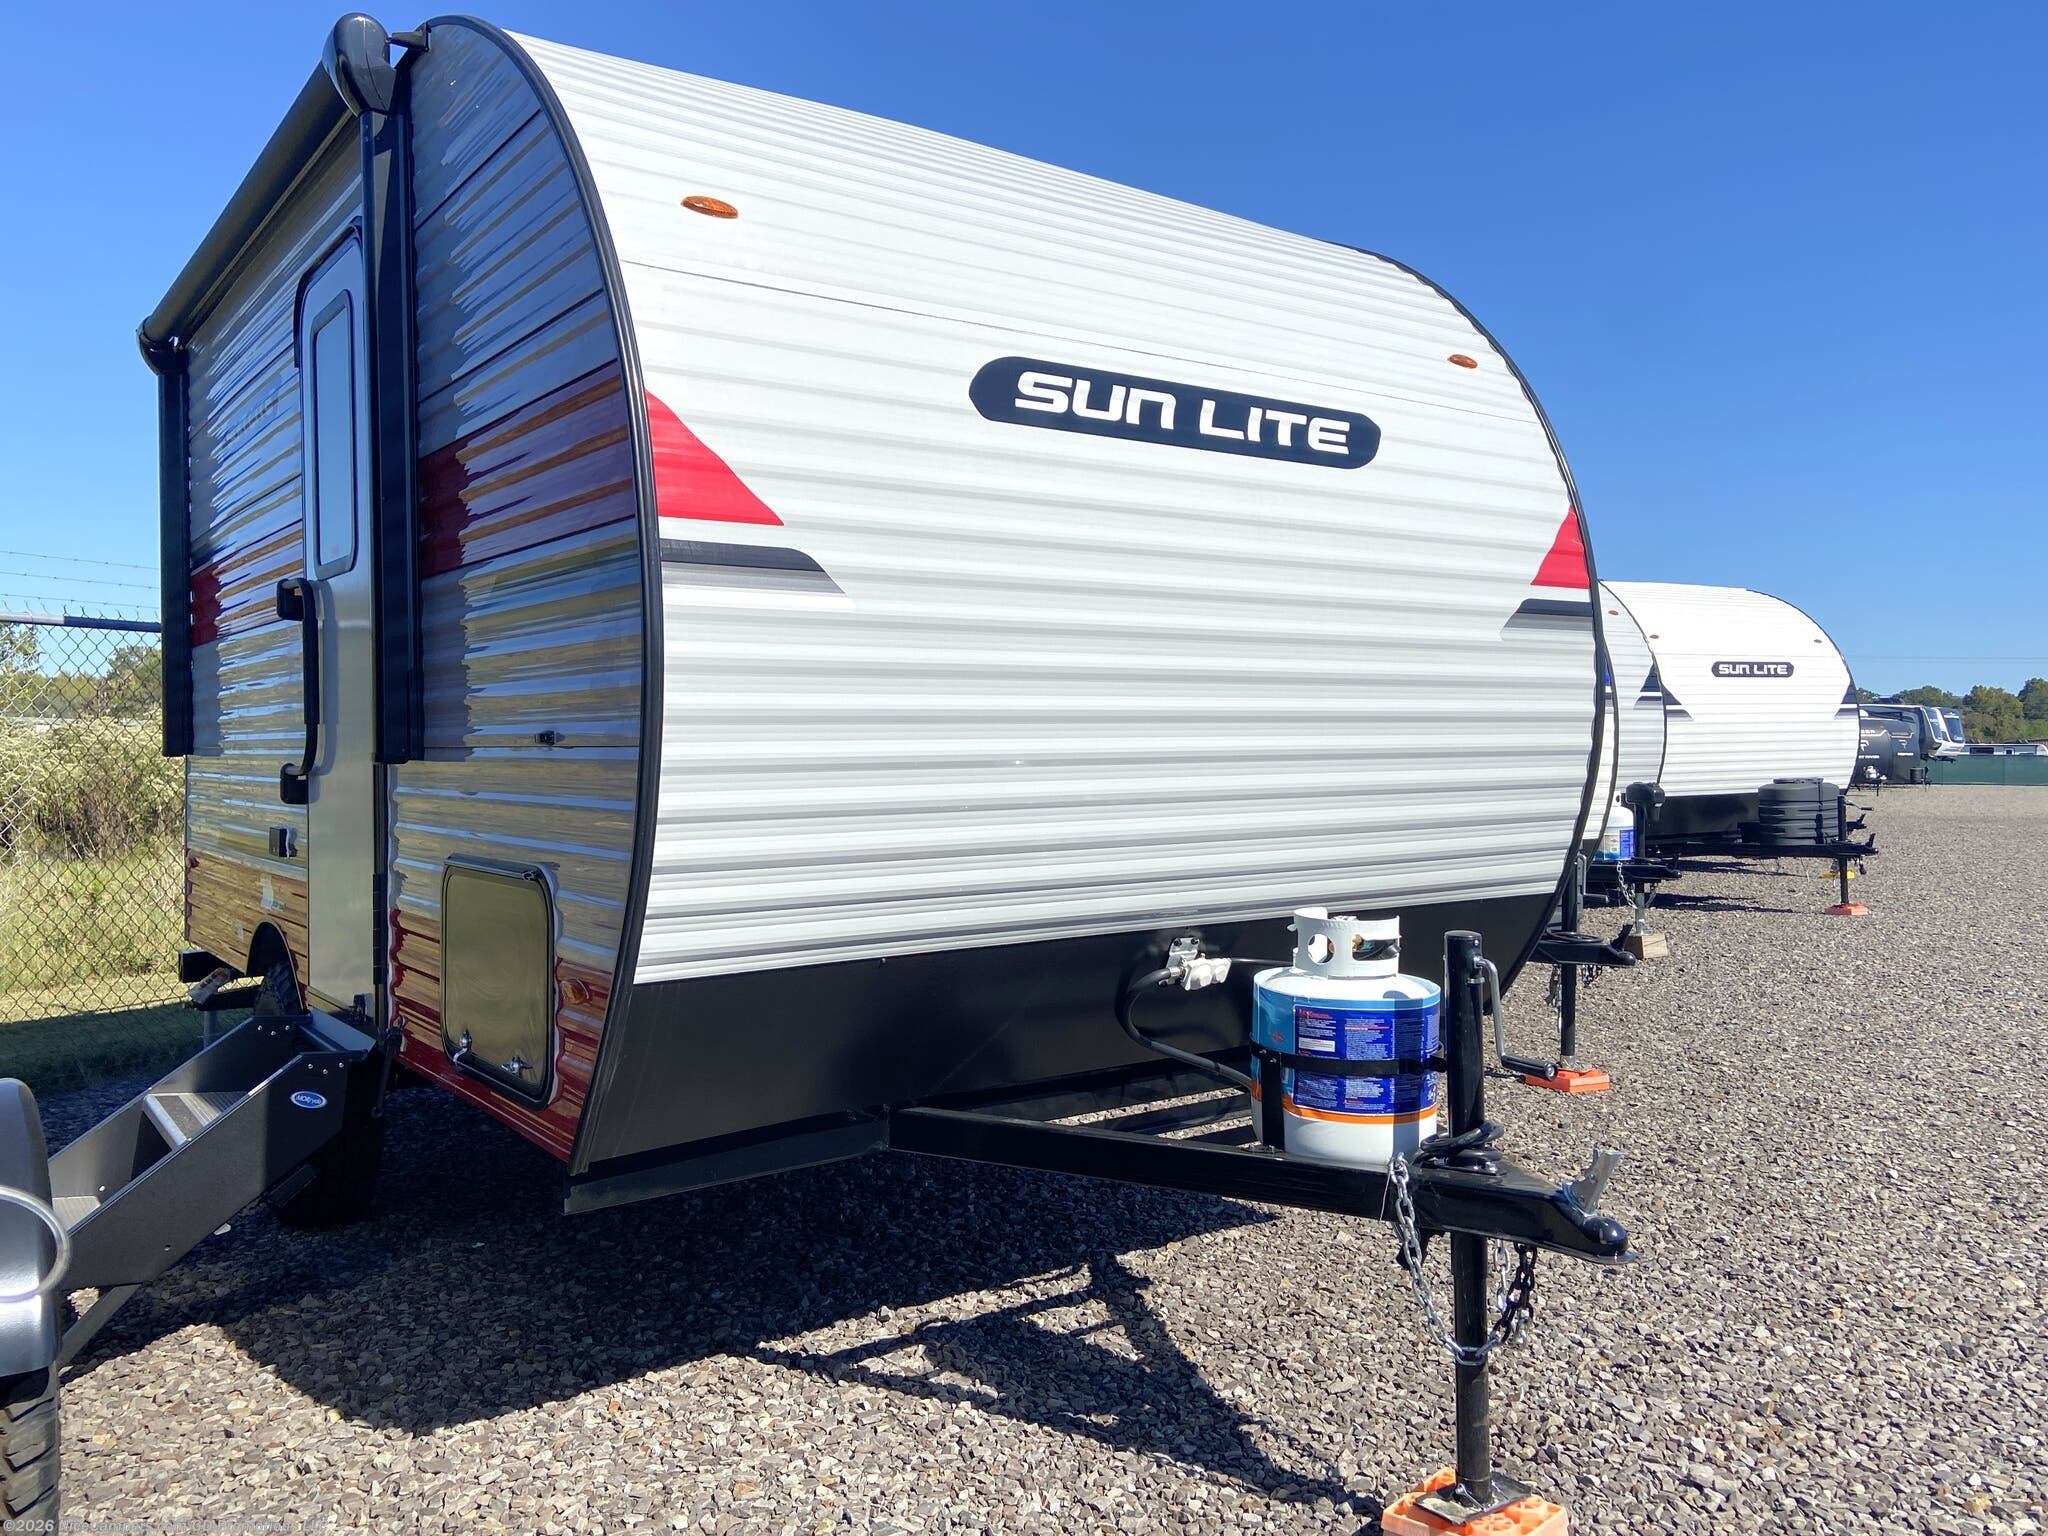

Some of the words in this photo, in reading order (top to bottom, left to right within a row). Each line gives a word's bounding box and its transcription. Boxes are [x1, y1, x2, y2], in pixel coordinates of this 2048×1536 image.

[1014, 370, 1177, 430] SUN
[1199, 398, 1351, 455] LITE
[1718, 663, 1750, 675] SUN
[1753, 664, 1788, 675] LITE
